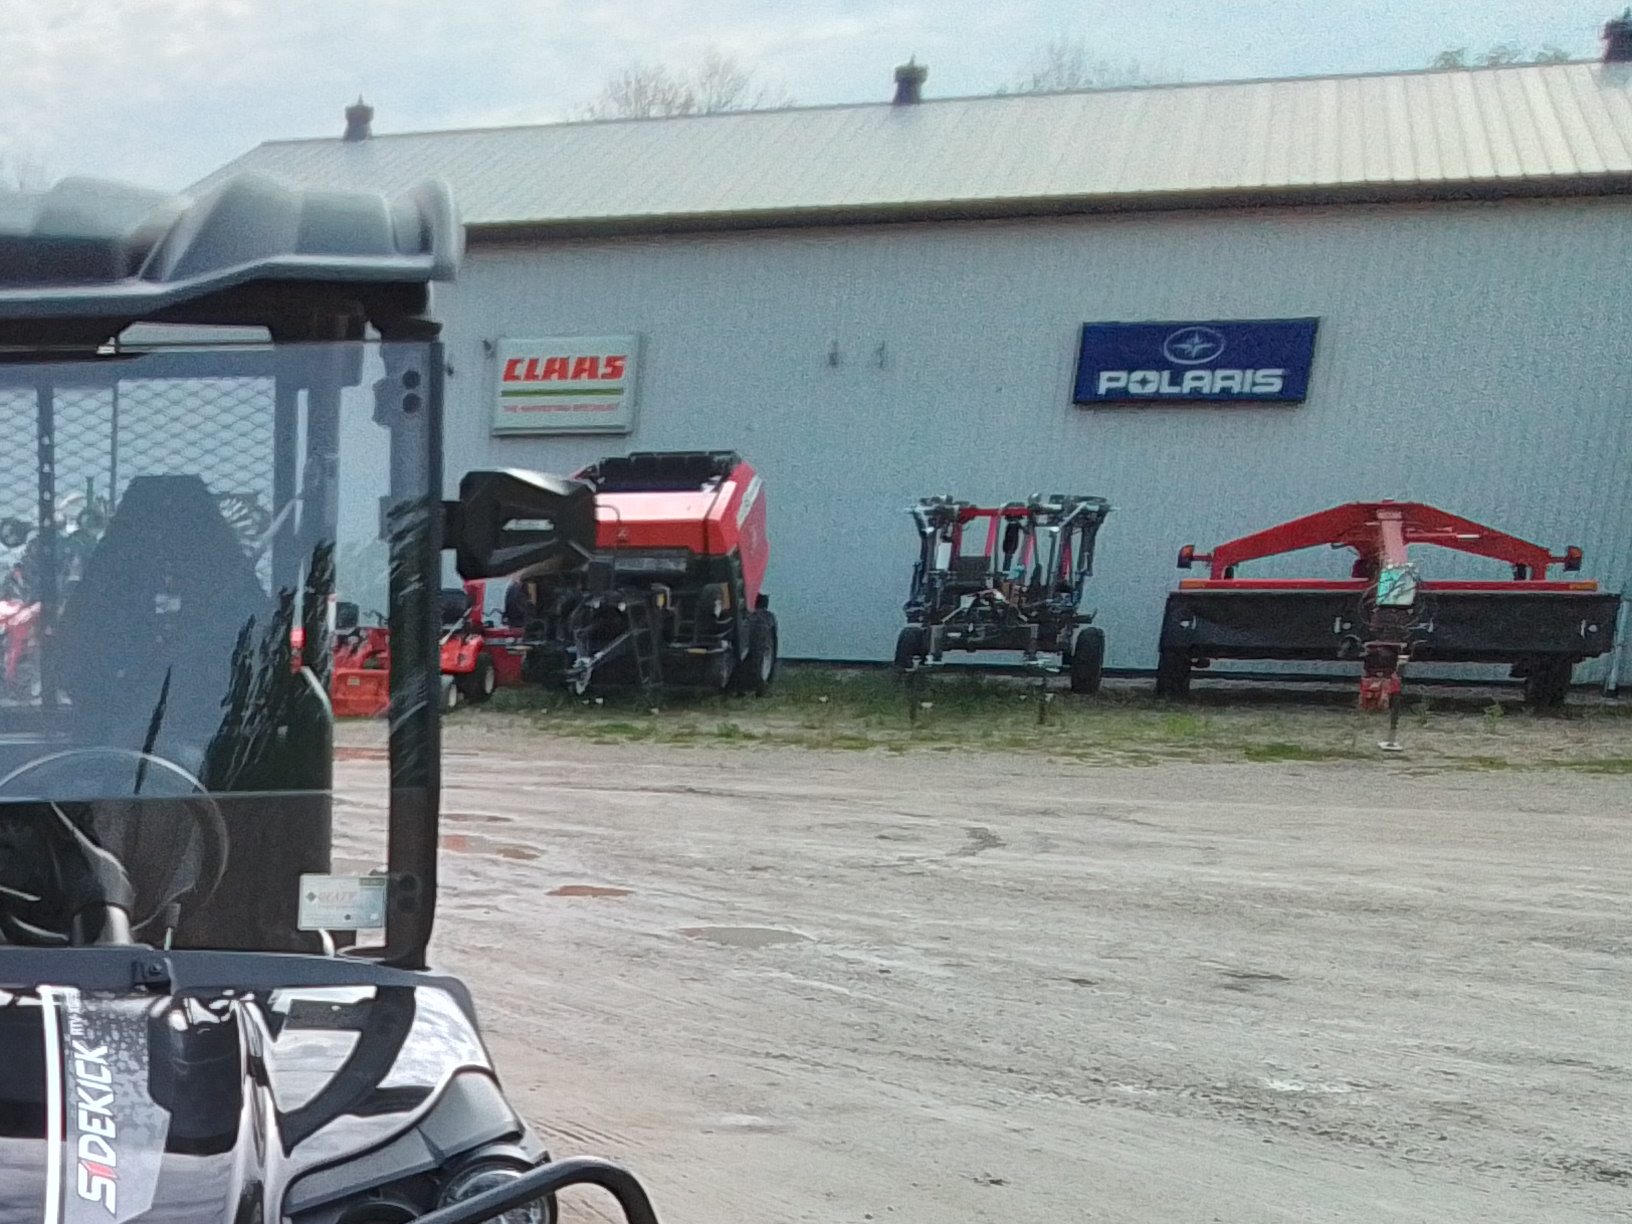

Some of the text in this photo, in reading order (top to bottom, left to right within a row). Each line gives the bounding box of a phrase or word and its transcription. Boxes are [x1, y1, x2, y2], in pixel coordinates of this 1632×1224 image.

[502, 355, 628, 383] CLAAS
[1097, 368, 1286, 396] POLARIS
[73, 1039, 118, 1218] SIDEKICK
